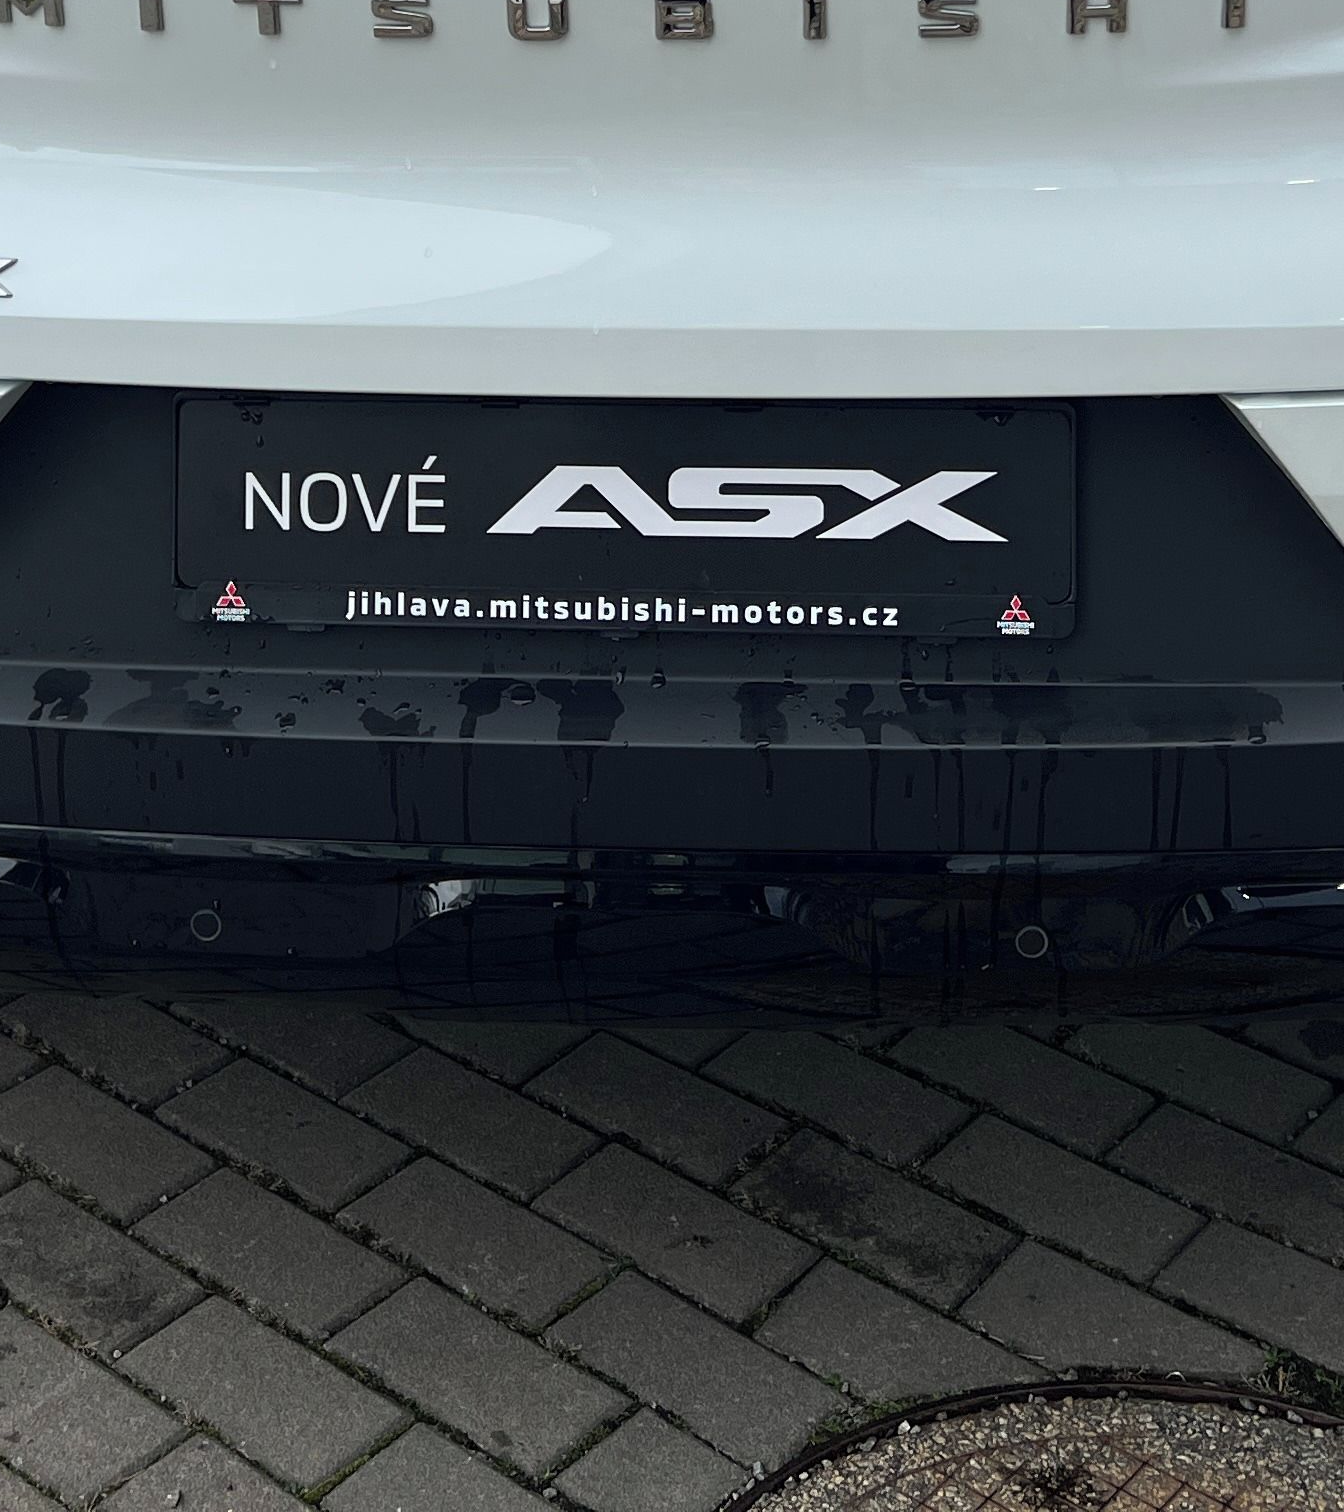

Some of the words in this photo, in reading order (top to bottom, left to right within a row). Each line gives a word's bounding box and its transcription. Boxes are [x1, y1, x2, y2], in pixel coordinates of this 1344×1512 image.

[243, 455, 446, 534] NOVÉ
[486, 464, 1010, 543] ASX
[345, 590, 899, 627] jihlava.mitsubishi-motors.cz
